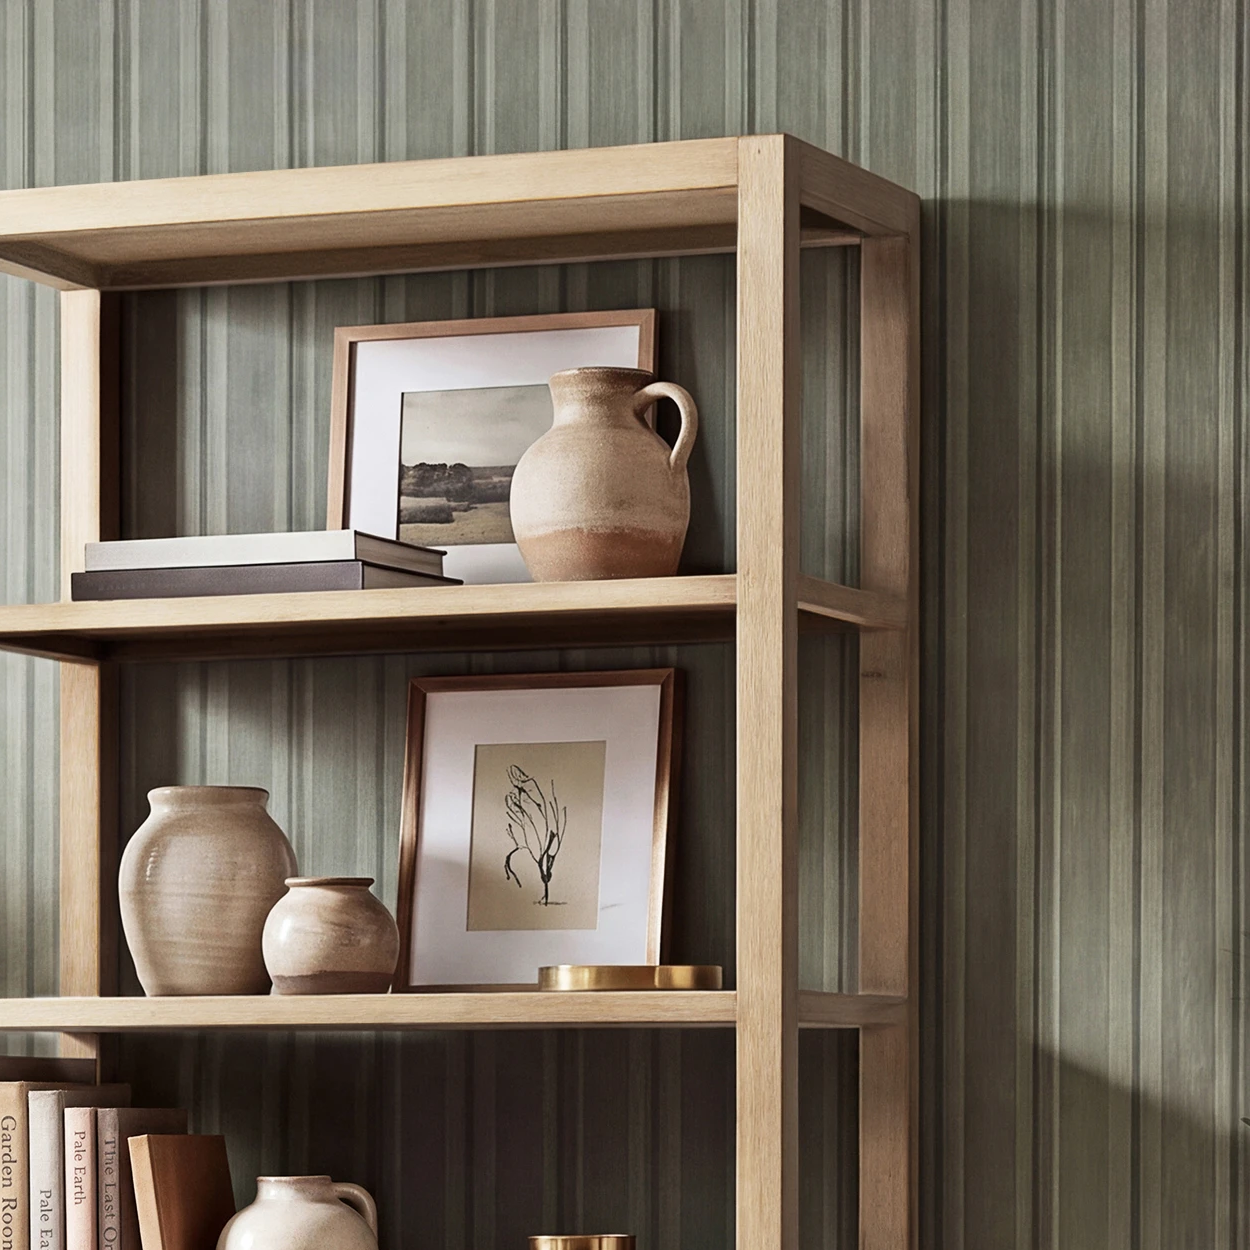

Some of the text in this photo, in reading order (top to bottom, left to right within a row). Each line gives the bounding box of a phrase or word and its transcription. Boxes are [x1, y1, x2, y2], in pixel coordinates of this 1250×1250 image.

[0, 1115, 17, 1188] Garden
[74, 1130, 86, 1205] Pale Earth
[40, 1189, 52, 1222] Pale
[104, 1182, 117, 1220] Last
